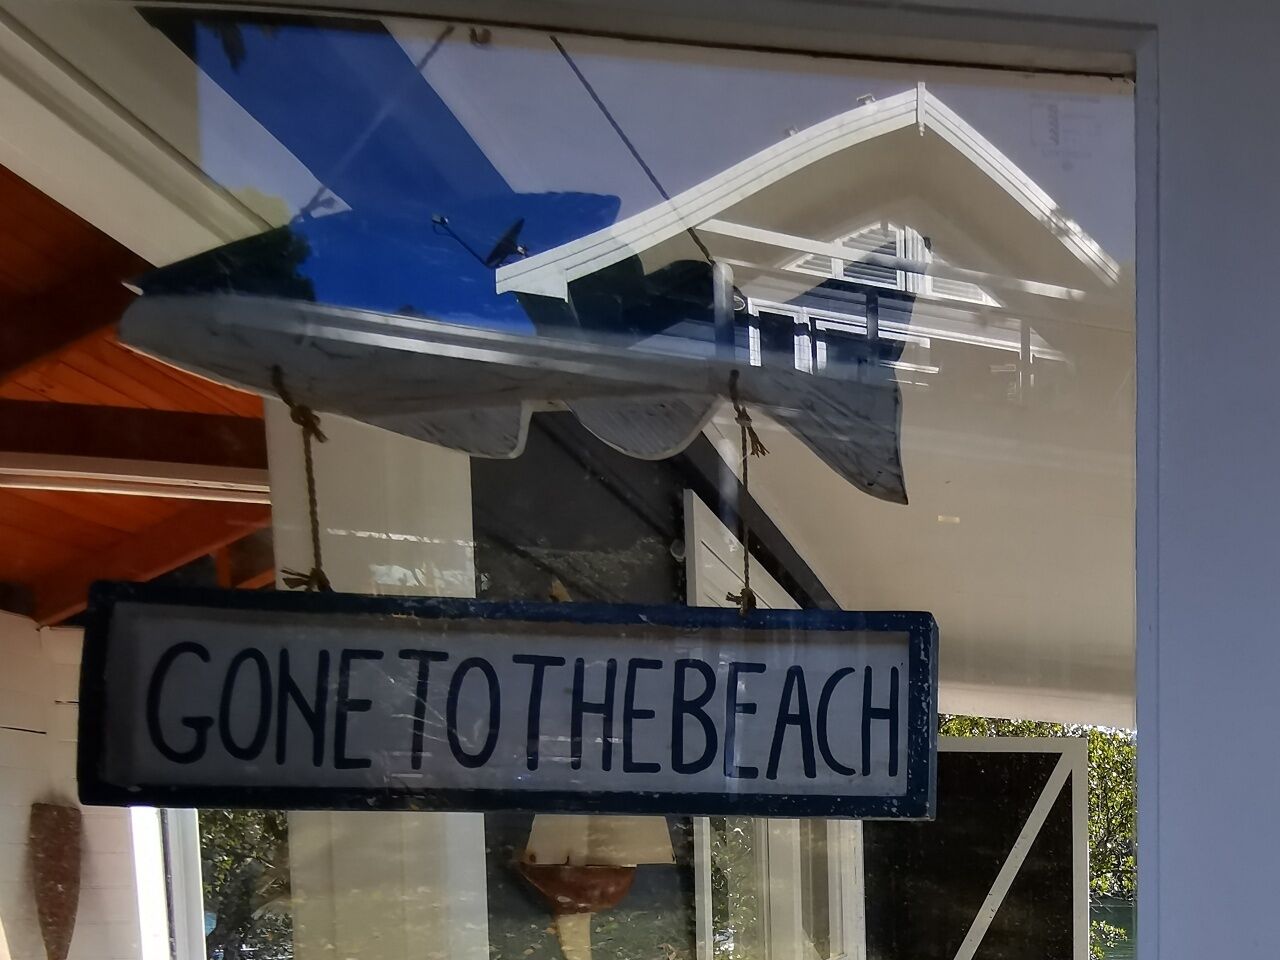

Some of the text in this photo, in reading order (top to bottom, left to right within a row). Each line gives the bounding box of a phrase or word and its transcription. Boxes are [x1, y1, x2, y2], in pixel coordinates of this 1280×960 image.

[146, 641, 900, 780] GONE TO THE BEACH
